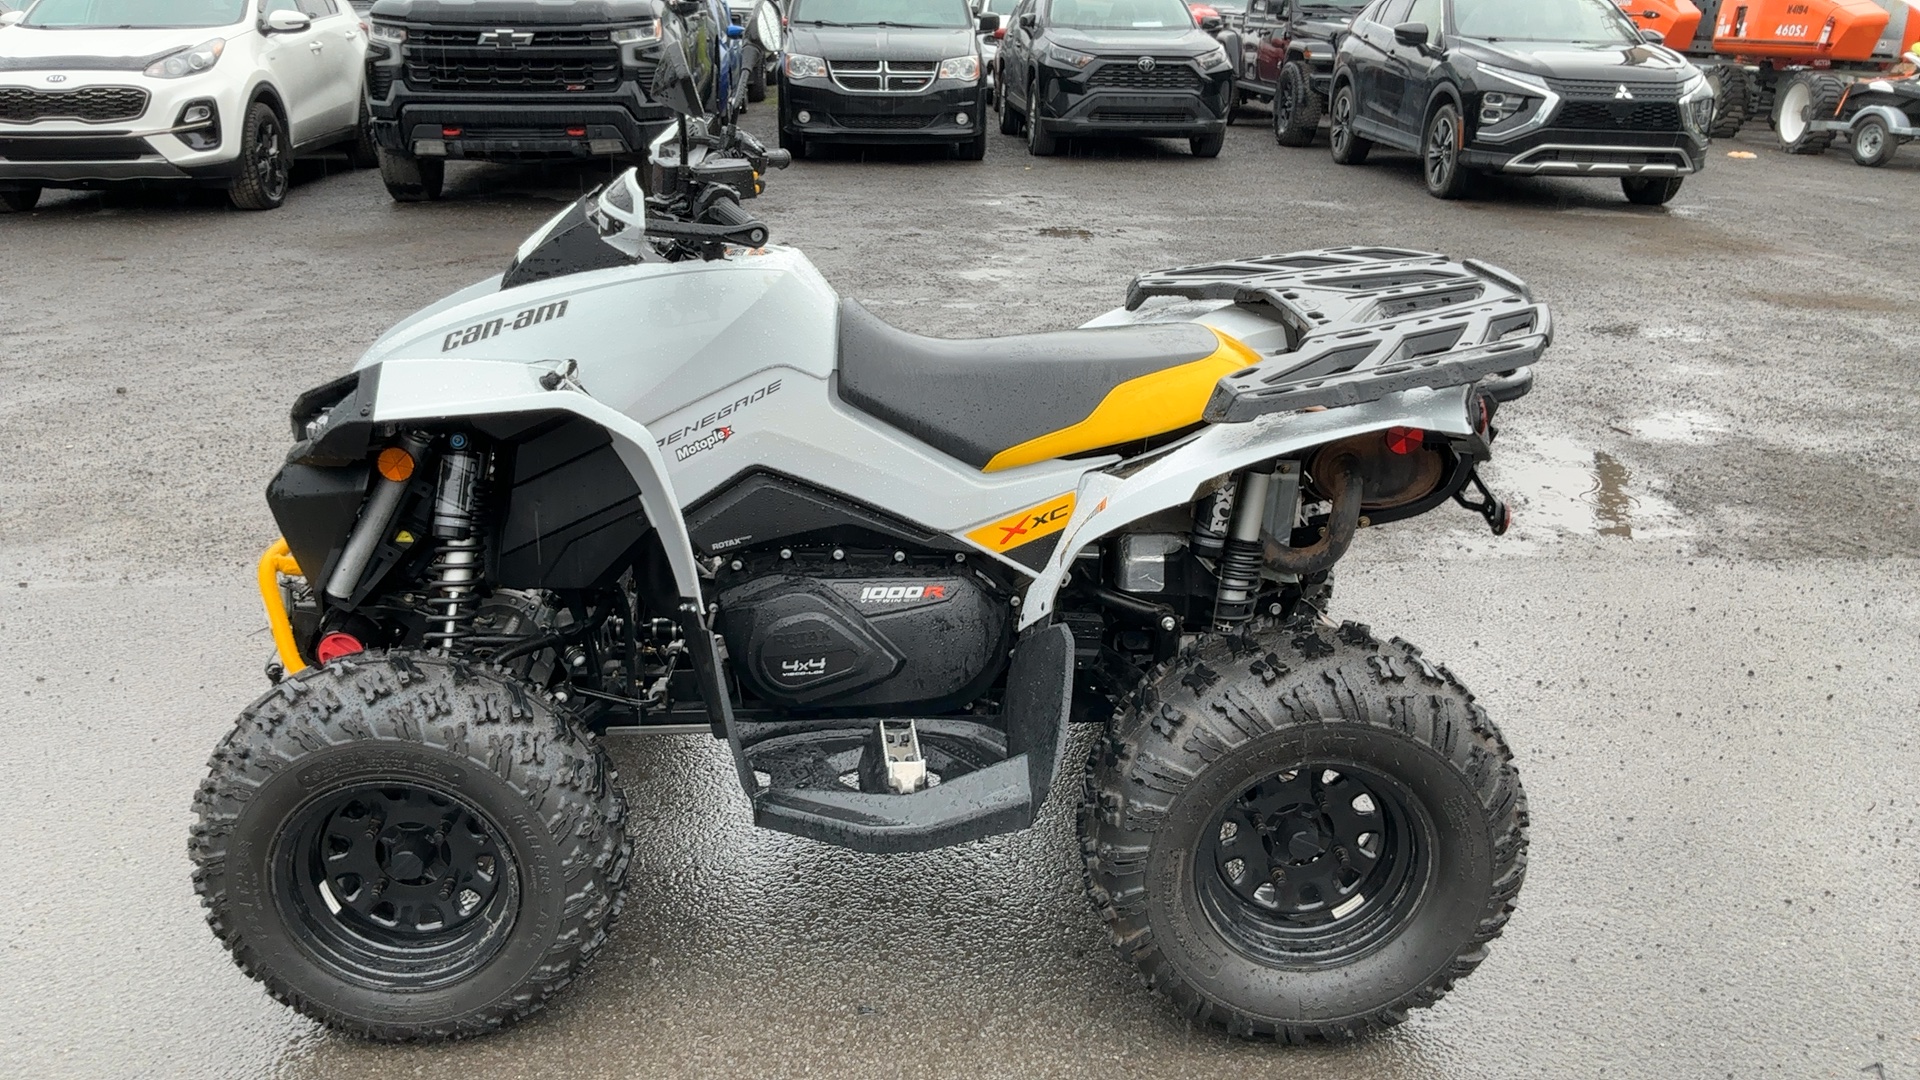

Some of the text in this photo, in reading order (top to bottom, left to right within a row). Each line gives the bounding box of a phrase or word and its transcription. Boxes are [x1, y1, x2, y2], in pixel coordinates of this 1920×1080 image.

[1774, 24, 1809, 37] 460SJ
[711, 537, 742, 551] ROTAX
[861, 585, 945, 599] 1000R
[781, 657, 827, 671] 4x4
